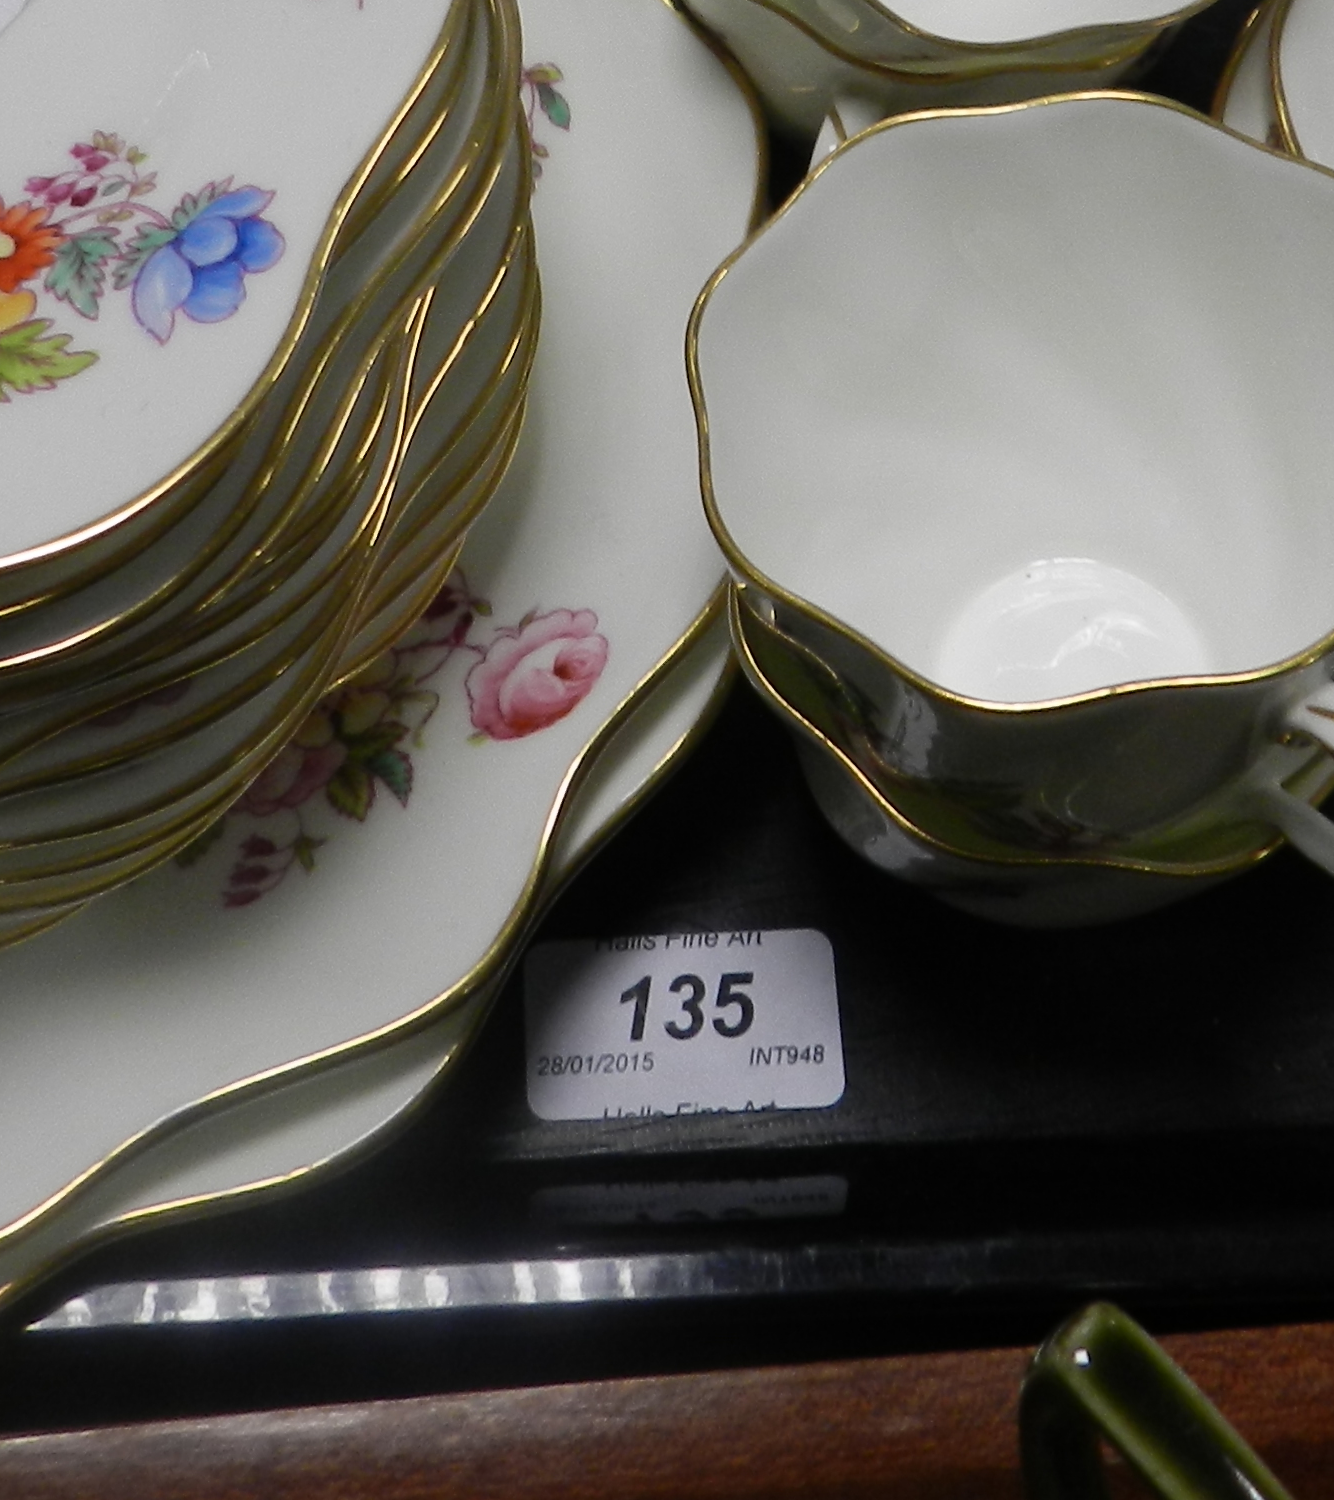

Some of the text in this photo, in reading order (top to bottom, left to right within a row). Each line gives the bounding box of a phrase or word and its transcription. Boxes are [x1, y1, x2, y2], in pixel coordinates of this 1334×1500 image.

[620, 972, 755, 1041] 135
[537, 1045, 826, 1076] 28/01/2015 INT948
